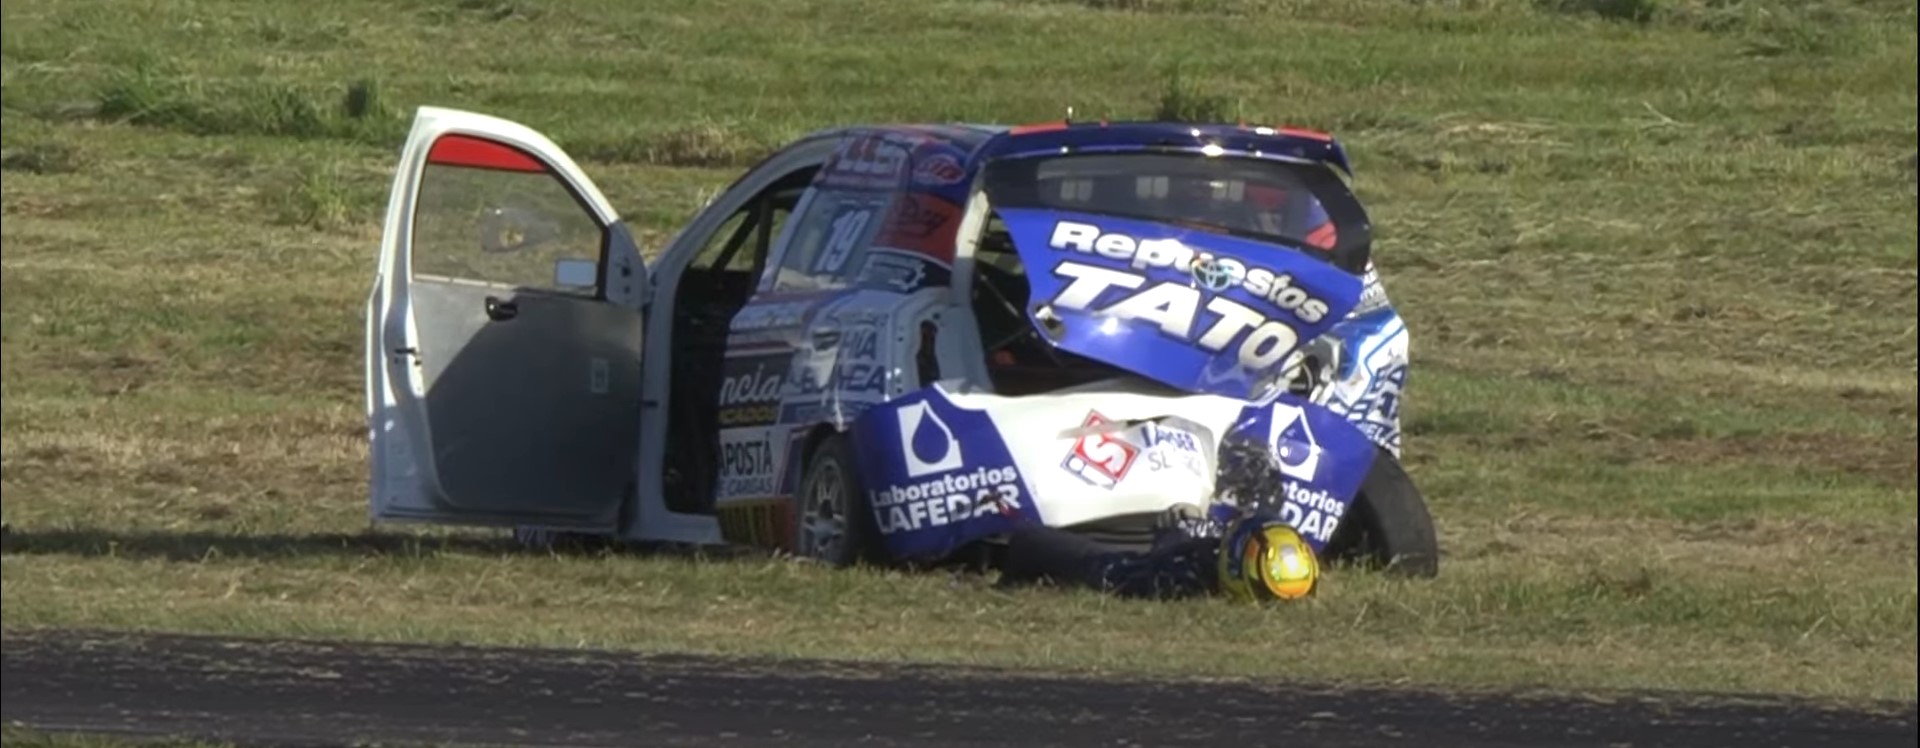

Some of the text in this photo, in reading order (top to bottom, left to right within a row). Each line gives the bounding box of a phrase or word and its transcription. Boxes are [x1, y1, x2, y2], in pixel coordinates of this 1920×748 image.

[815, 209, 871, 272] 19
[1053, 261, 1299, 371] TATO
[869, 465, 1018, 508] Laboratorios
[874, 484, 1021, 536] LAFEDAR
